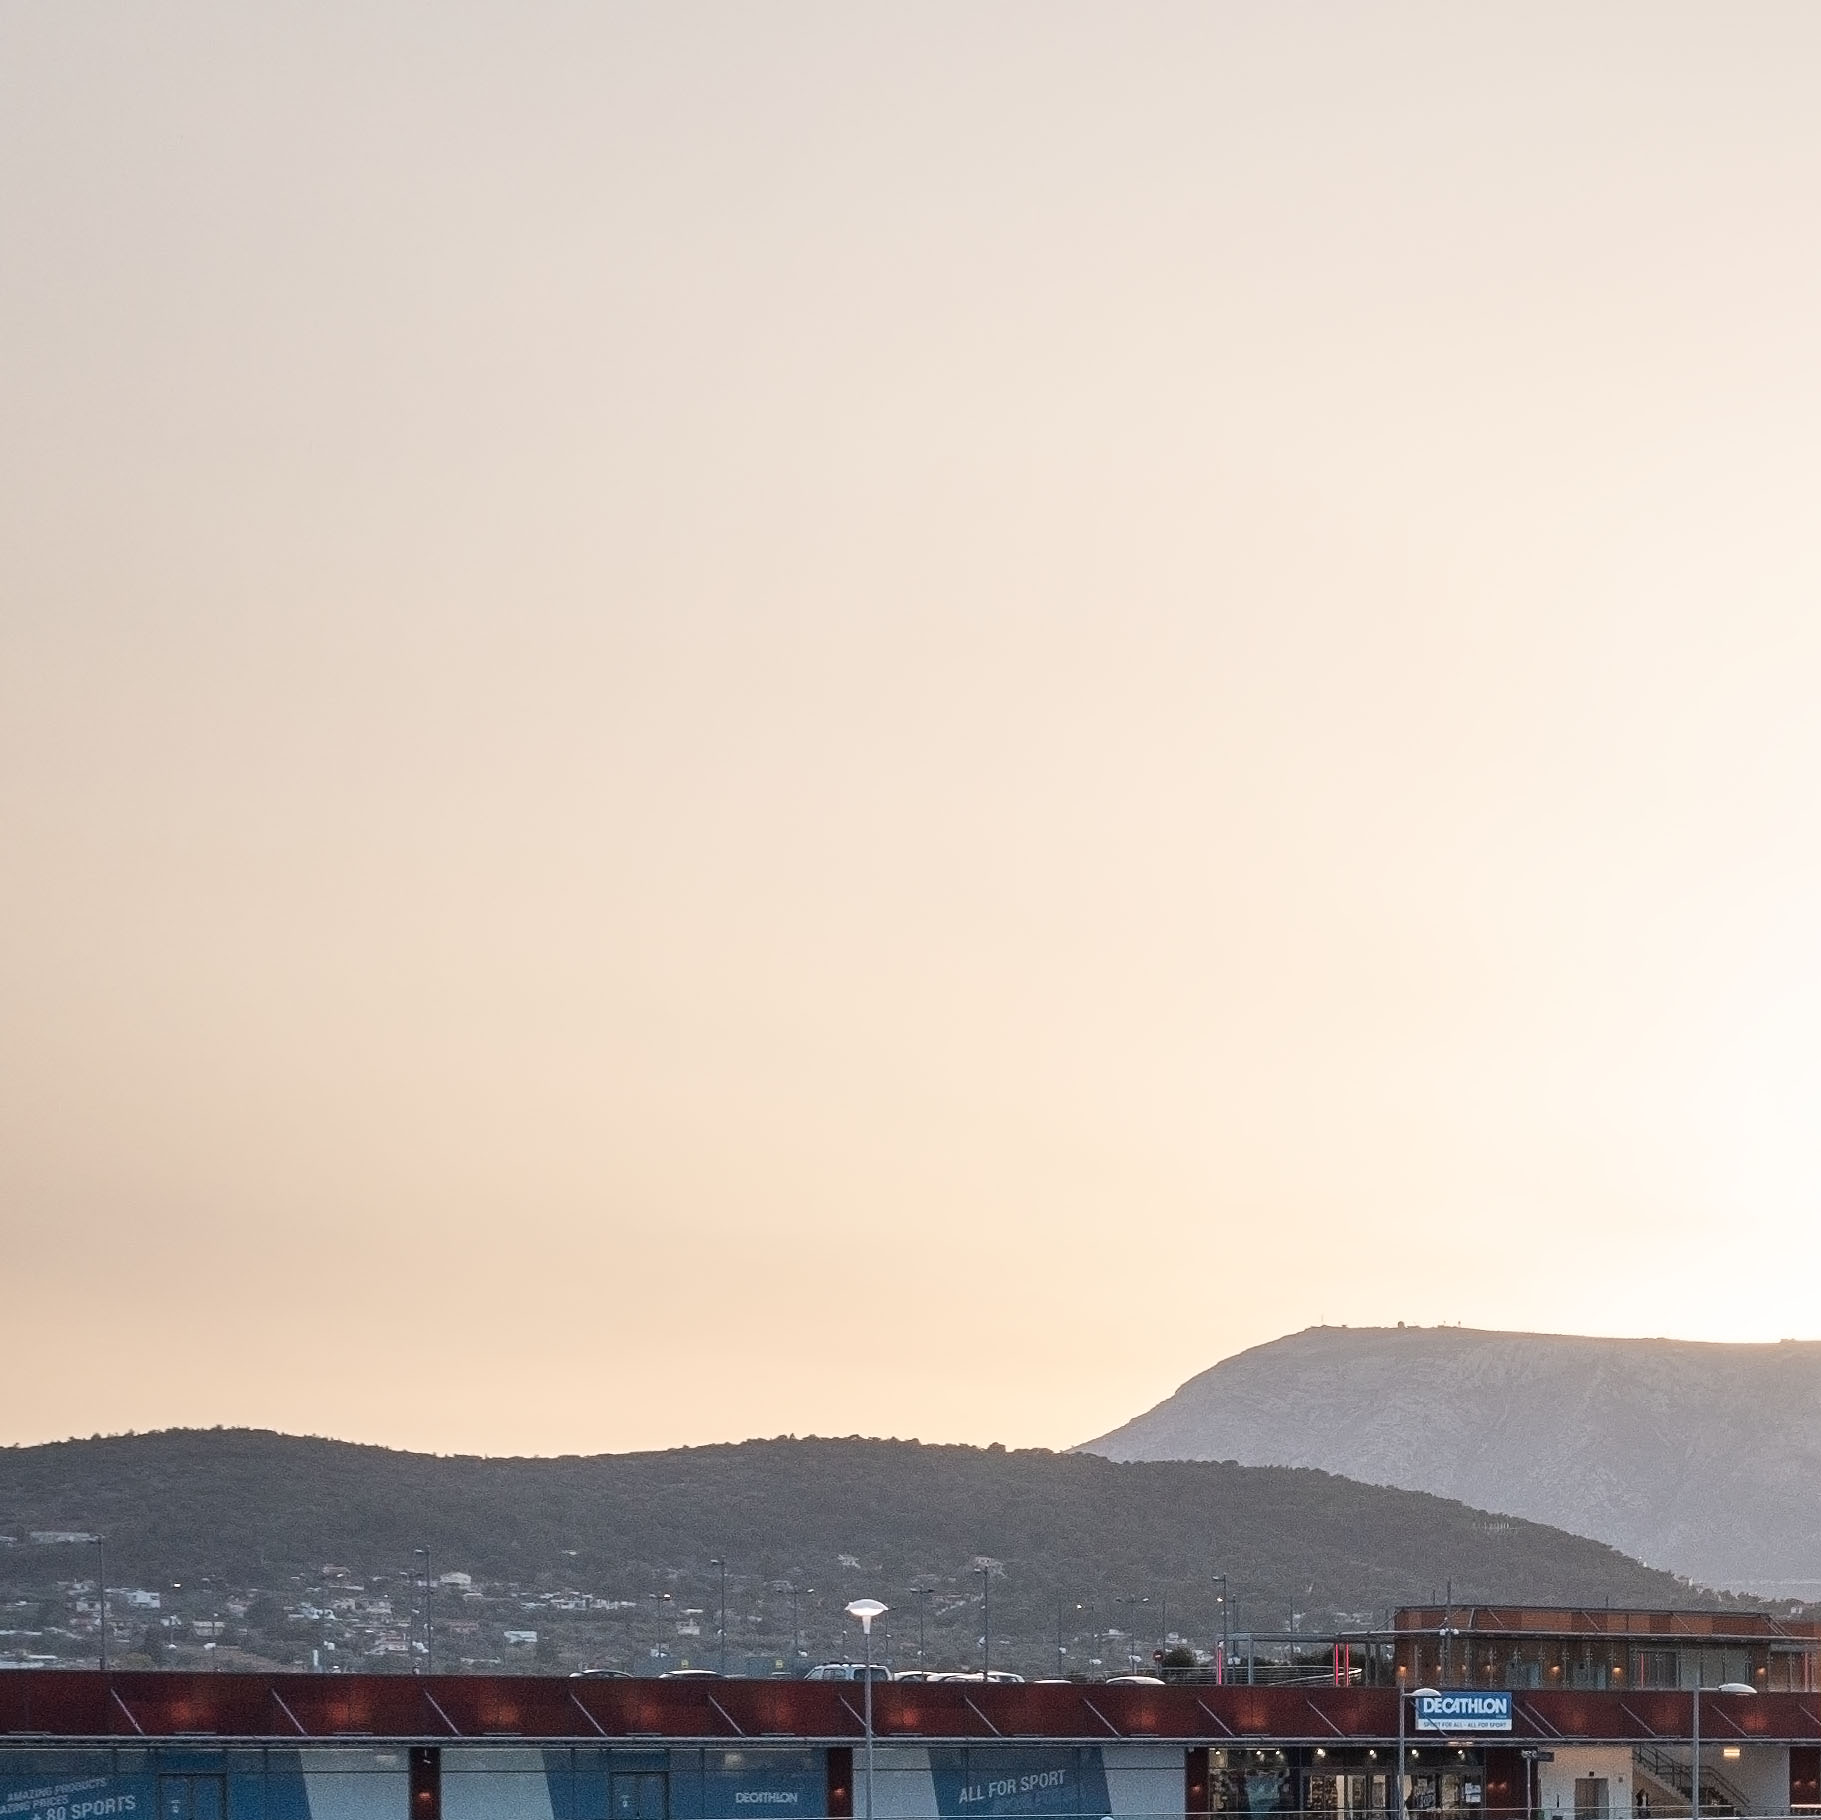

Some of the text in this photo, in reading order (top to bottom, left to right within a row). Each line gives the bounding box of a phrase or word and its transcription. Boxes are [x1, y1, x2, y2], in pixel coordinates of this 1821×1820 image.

[1423, 1697, 1507, 1714] DECATHLON
[959, 1769, 1066, 1804] ALL FOR SPORT
[71, 1794, 137, 1820] SPORTS
